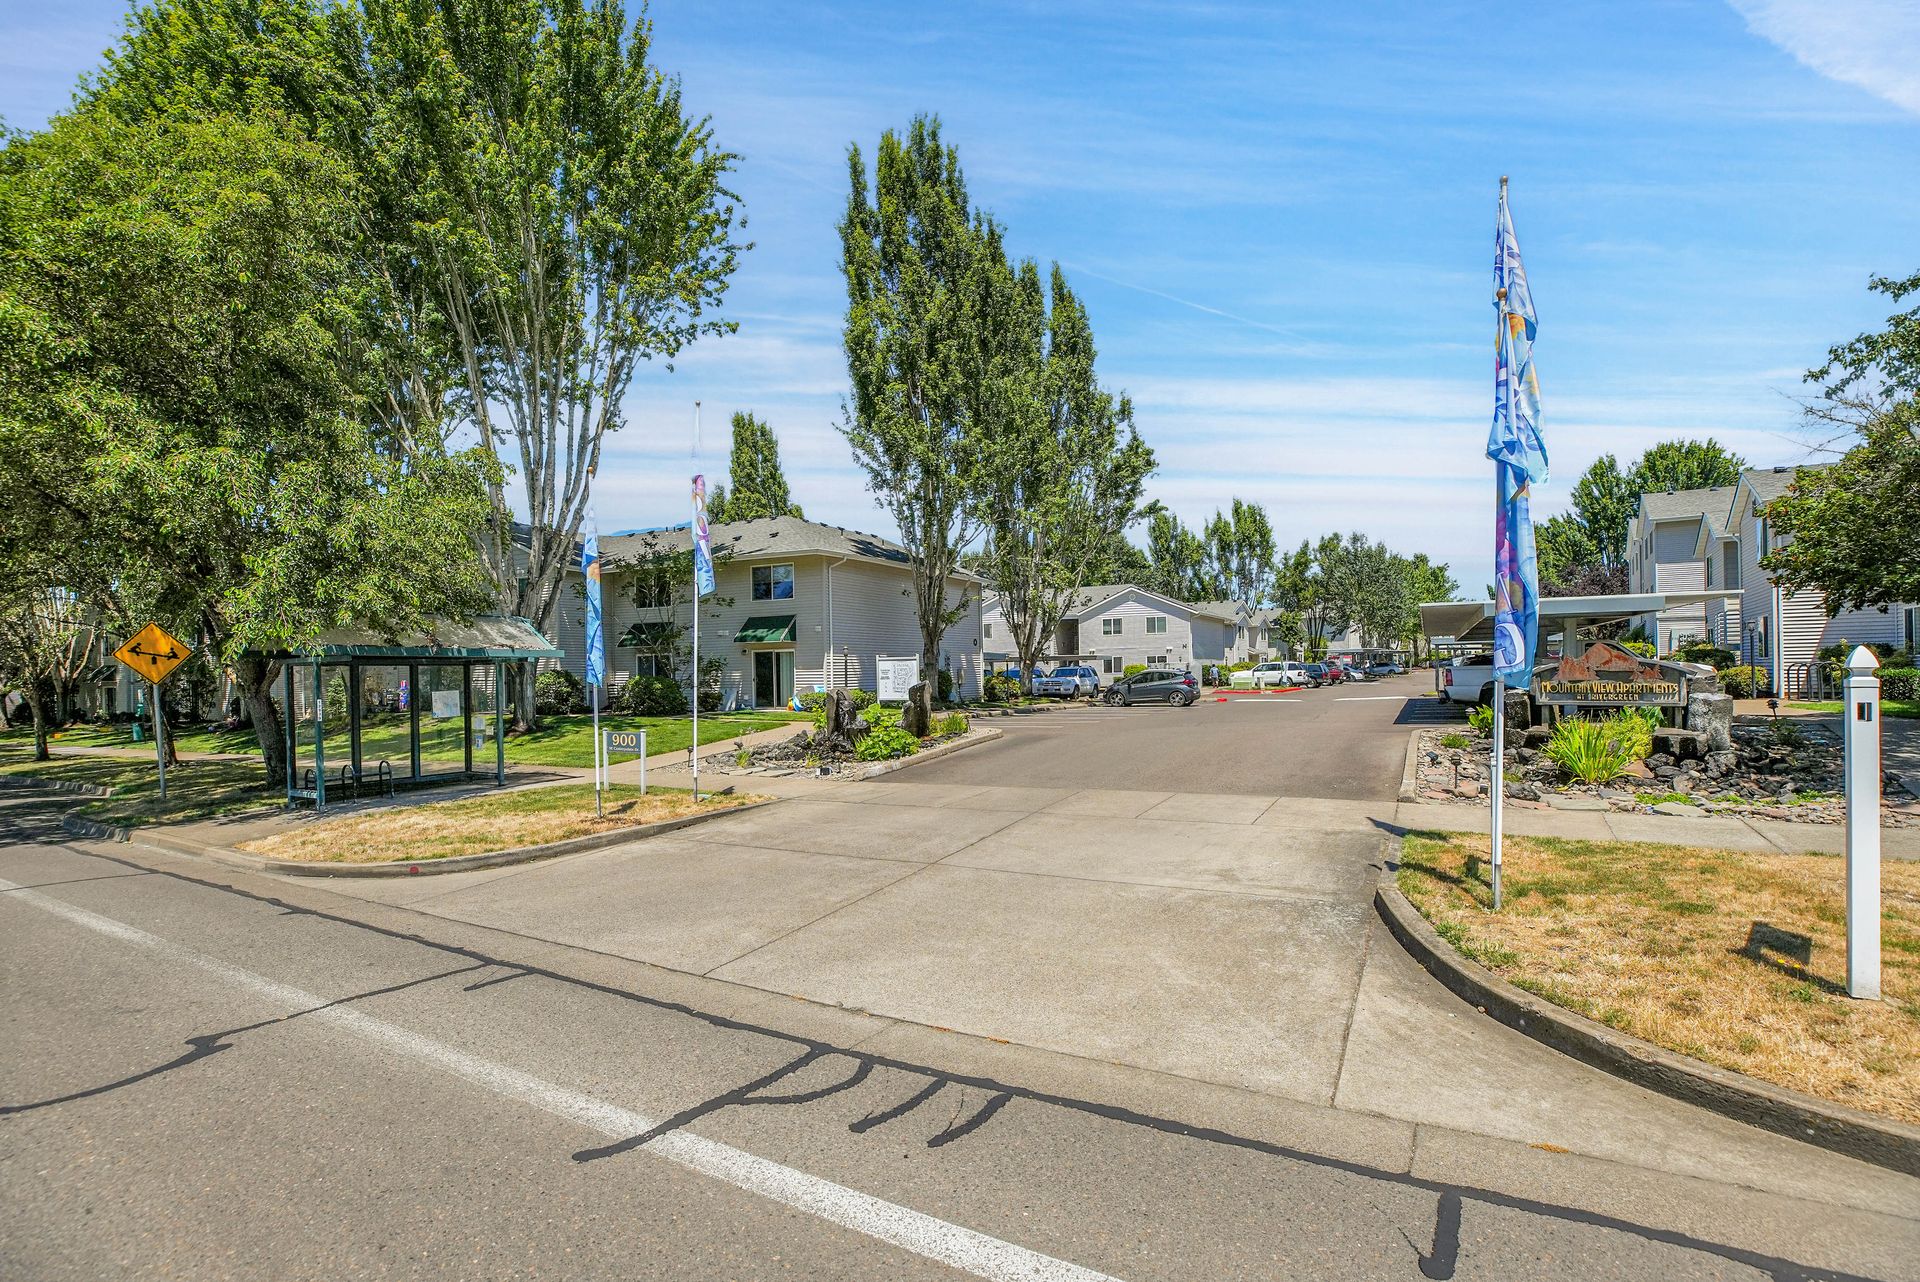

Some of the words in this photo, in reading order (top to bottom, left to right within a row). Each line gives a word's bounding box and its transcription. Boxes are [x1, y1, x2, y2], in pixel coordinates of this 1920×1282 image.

[1541, 681, 1590, 694] MOUNTAIN
[1591, 681, 1614, 693] VIEW
[1616, 681, 1679, 694] APARTMENTS
[612, 733, 636, 746] 900
